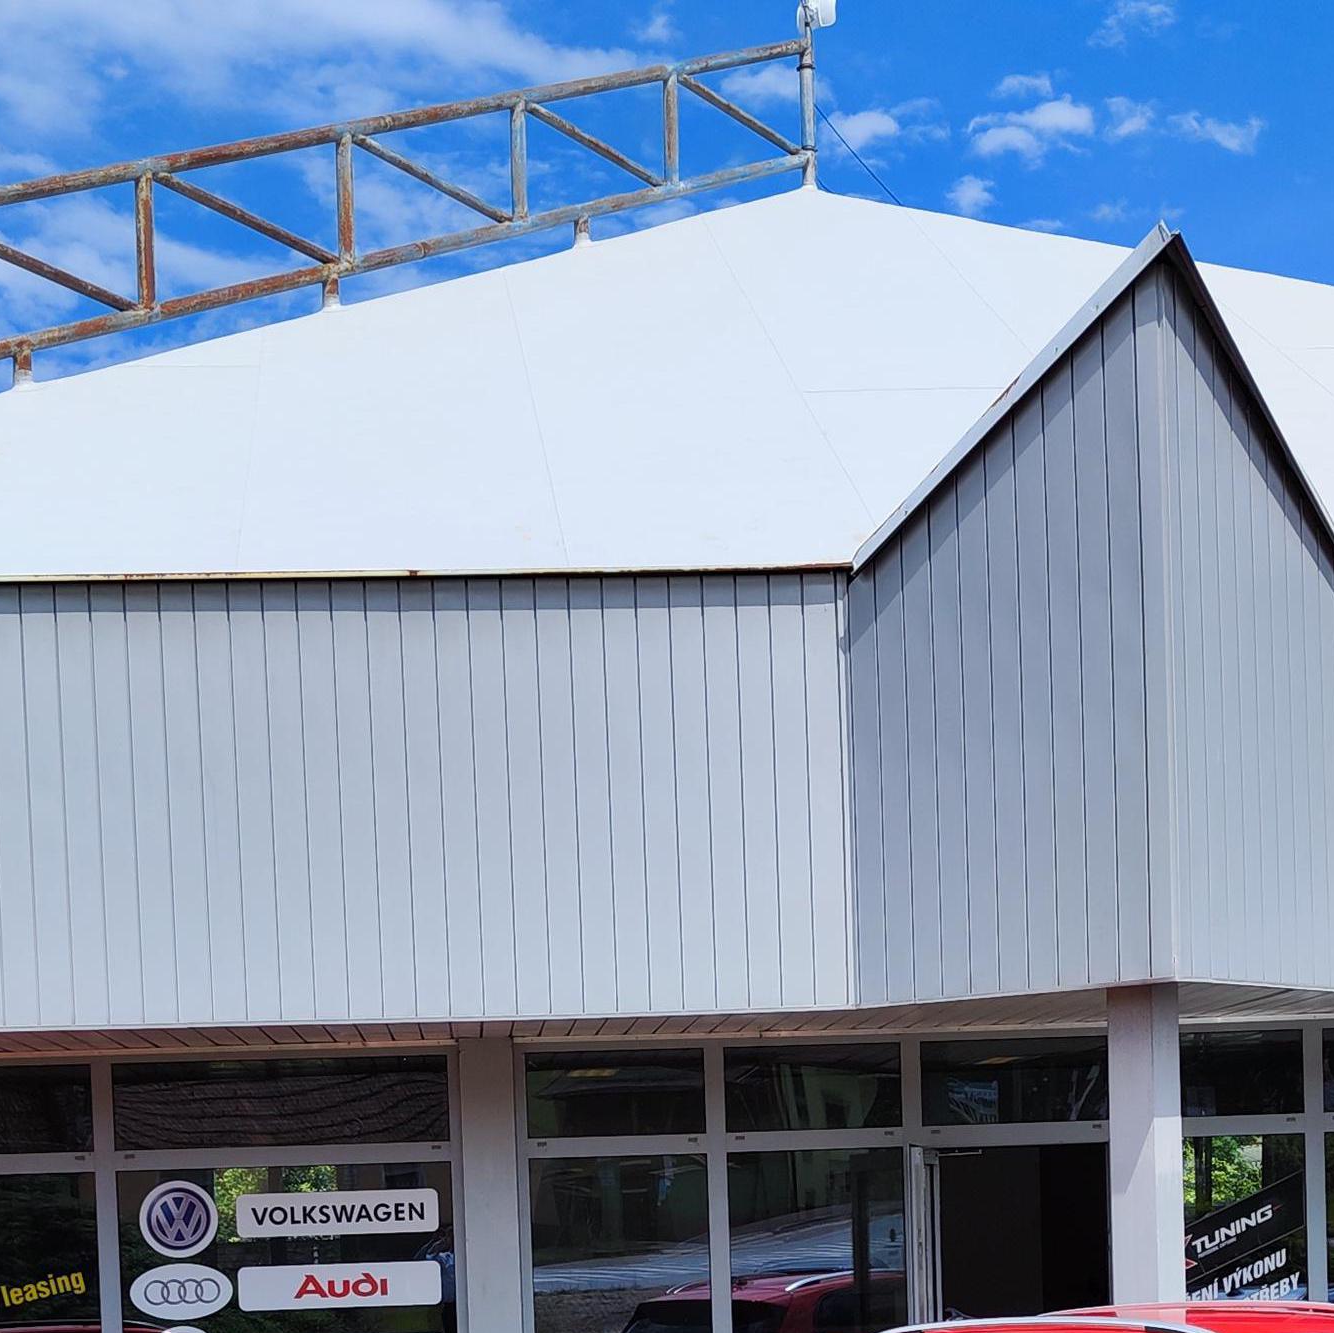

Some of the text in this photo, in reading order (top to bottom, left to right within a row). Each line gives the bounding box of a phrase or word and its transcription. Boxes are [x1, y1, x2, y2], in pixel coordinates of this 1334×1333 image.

[250, 1201, 426, 1227] VOLKSWAGEN
[1191, 1203, 1274, 1254] TUNING
[1, 1271, 86, 1308] leasing
[293, 1271, 389, 1300] Audi
[1222, 1248, 1287, 1295] VÝKONU
